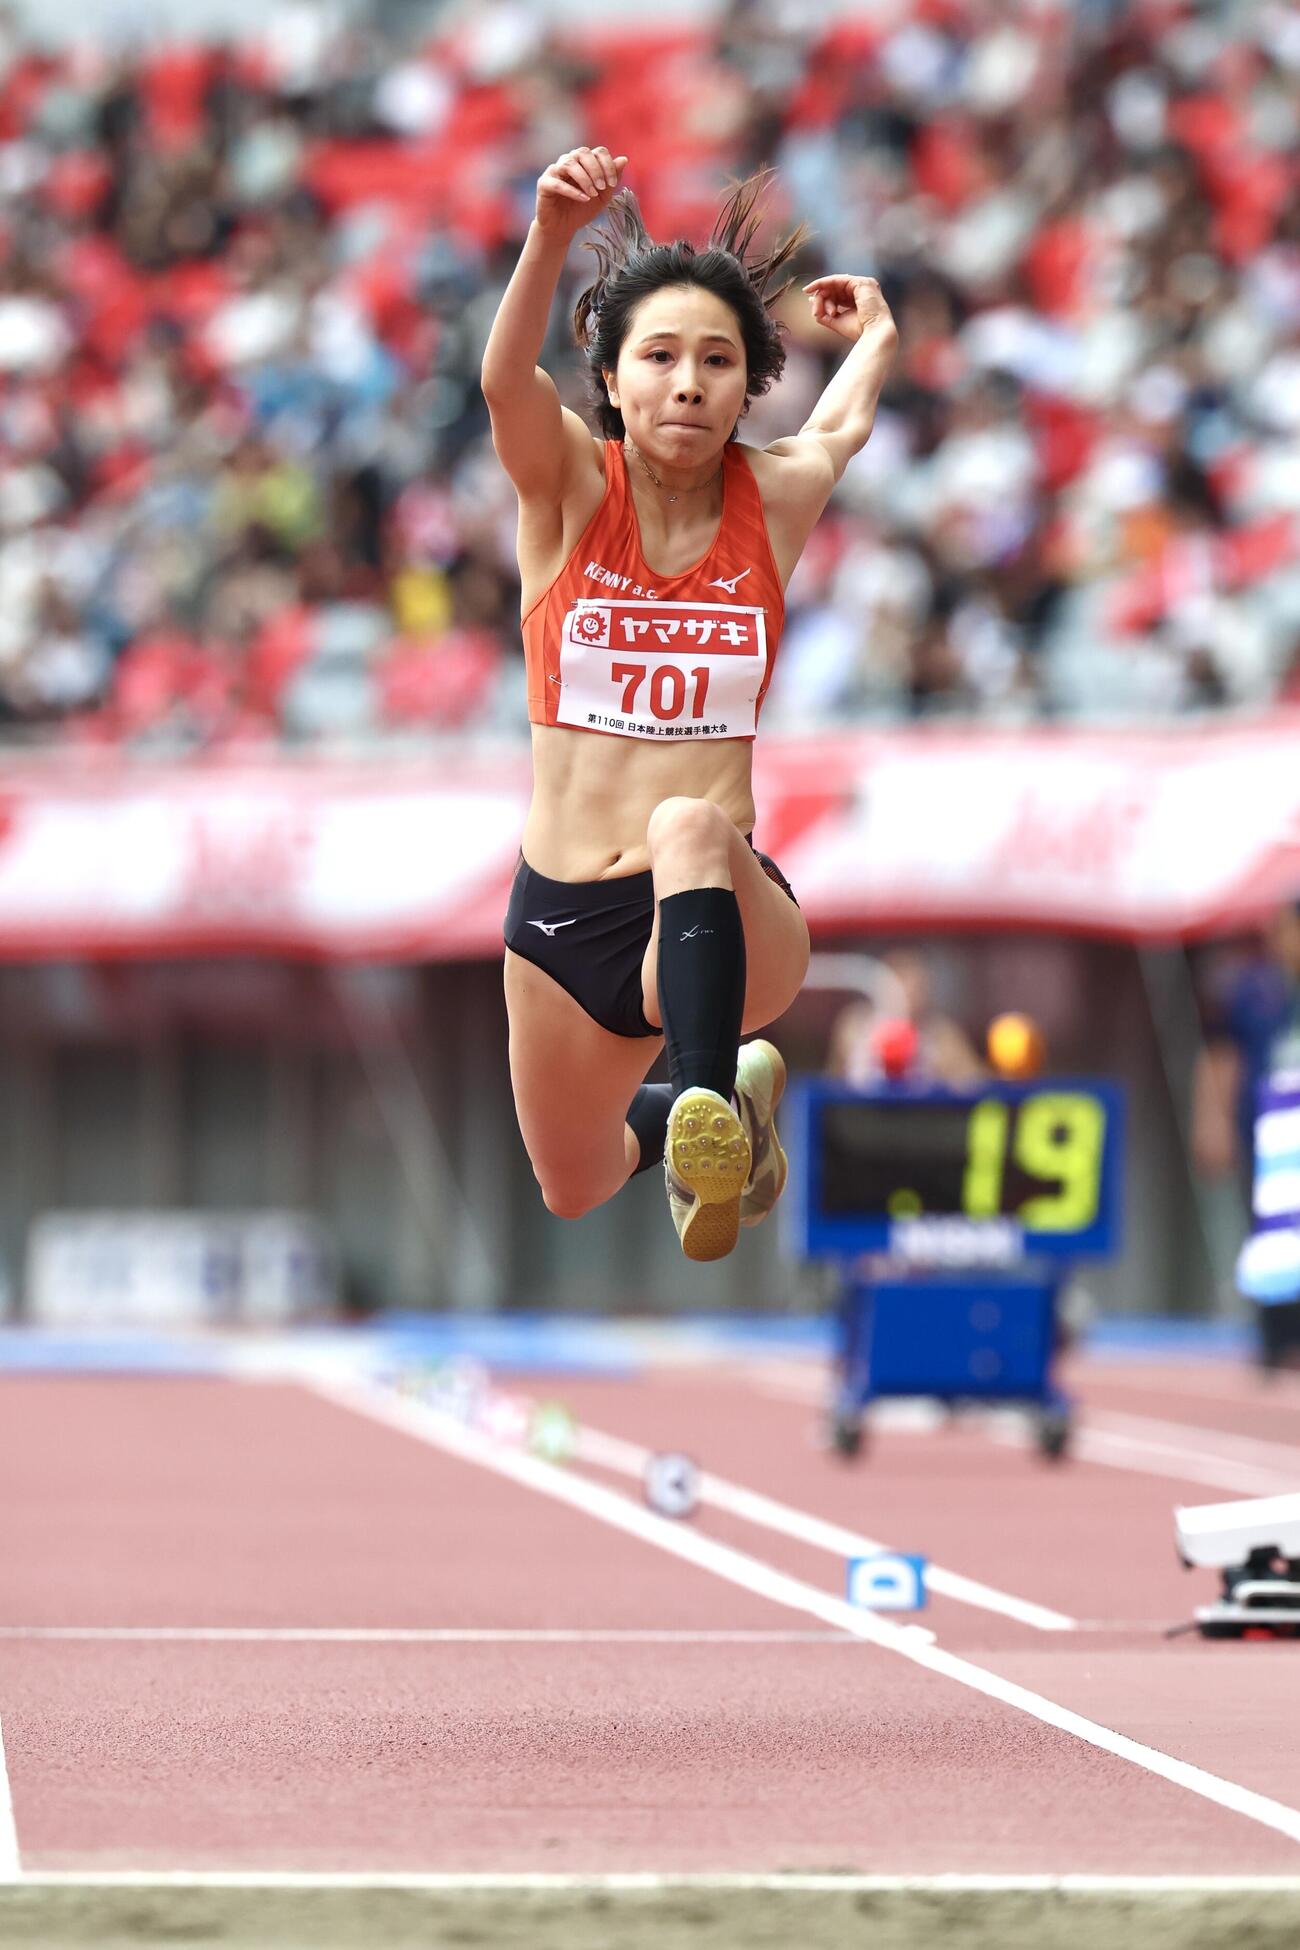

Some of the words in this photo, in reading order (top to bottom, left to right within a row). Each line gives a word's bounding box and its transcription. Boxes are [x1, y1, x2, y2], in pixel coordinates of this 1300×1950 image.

[583, 561, 633, 591] KENNY
[619, 616, 749, 646] ヤマザキ
[611, 661, 710, 721] 701
[587, 712, 625, 730] 第110回
[627, 722, 728, 736] 日本陸上競技選手権大会
